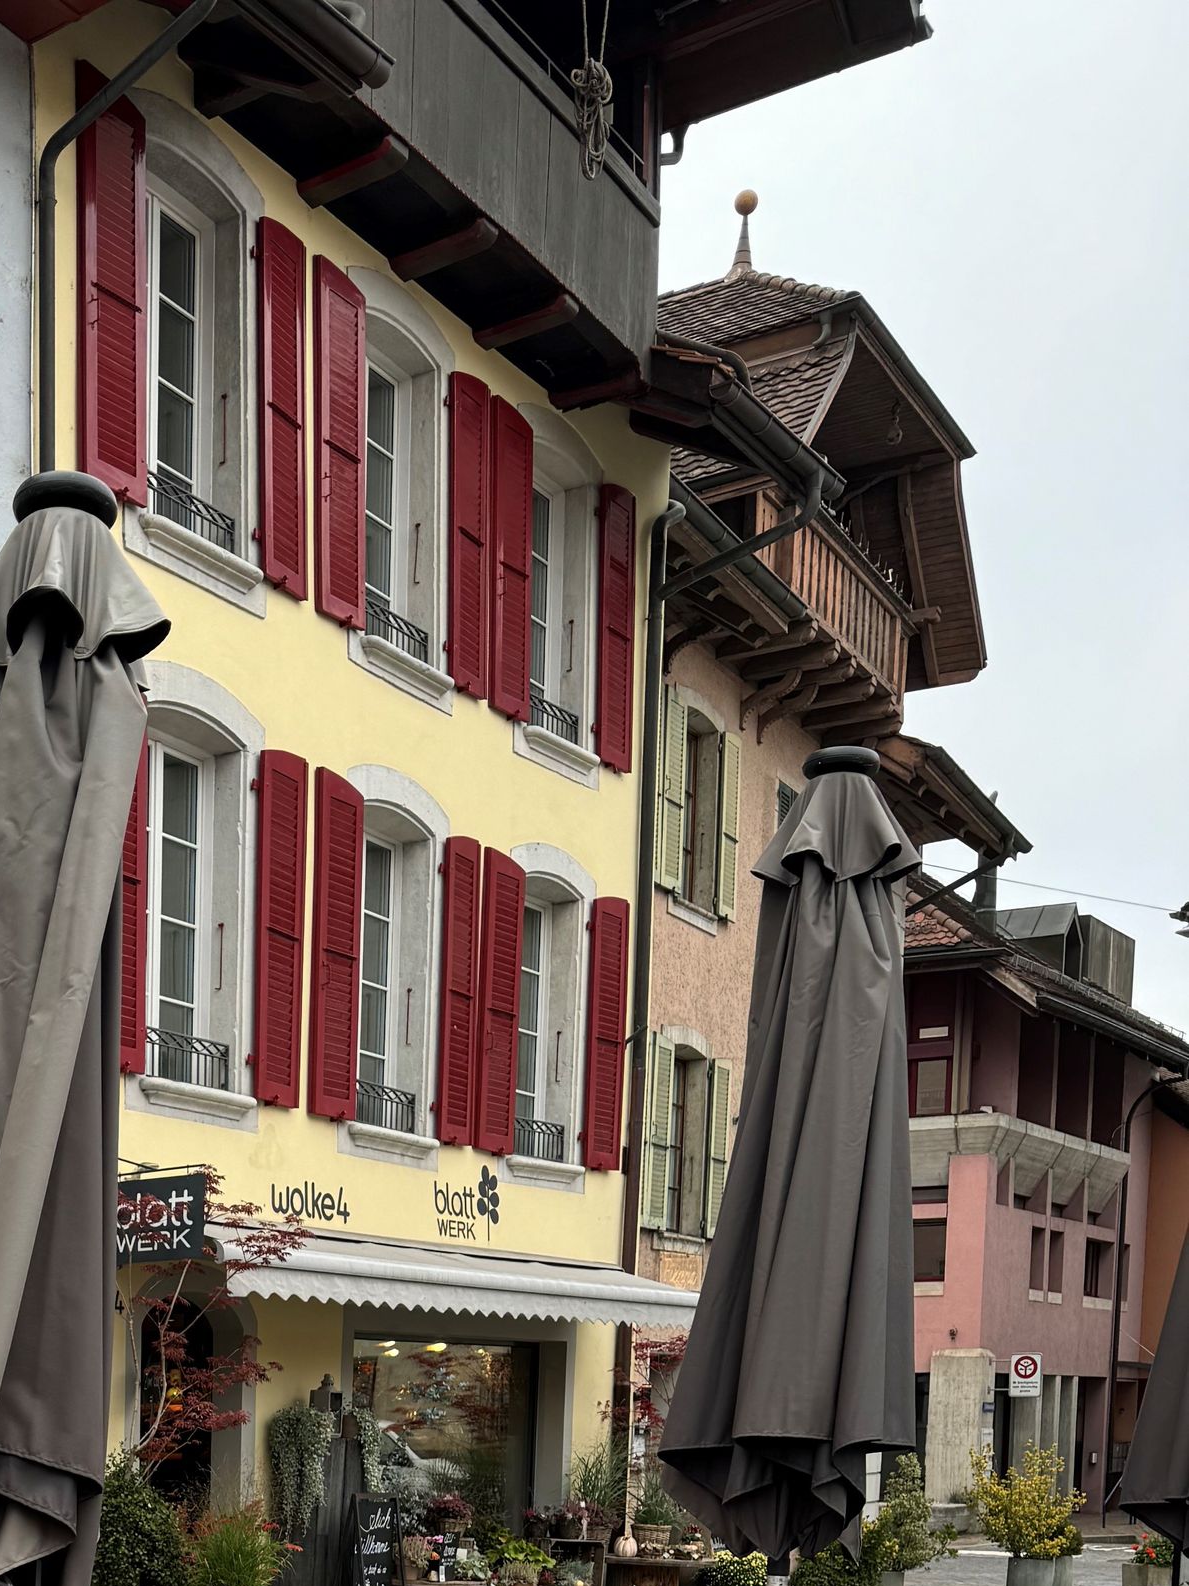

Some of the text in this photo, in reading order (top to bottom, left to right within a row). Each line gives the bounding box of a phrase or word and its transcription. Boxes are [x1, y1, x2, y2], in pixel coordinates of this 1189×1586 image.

[271, 1181, 351, 1225] wolke4
[434, 1181, 476, 1219] blatt
[117, 1228, 191, 1254] WERK
[437, 1218, 477, 1240] WERK
[115, 1290, 125, 1315] 4
